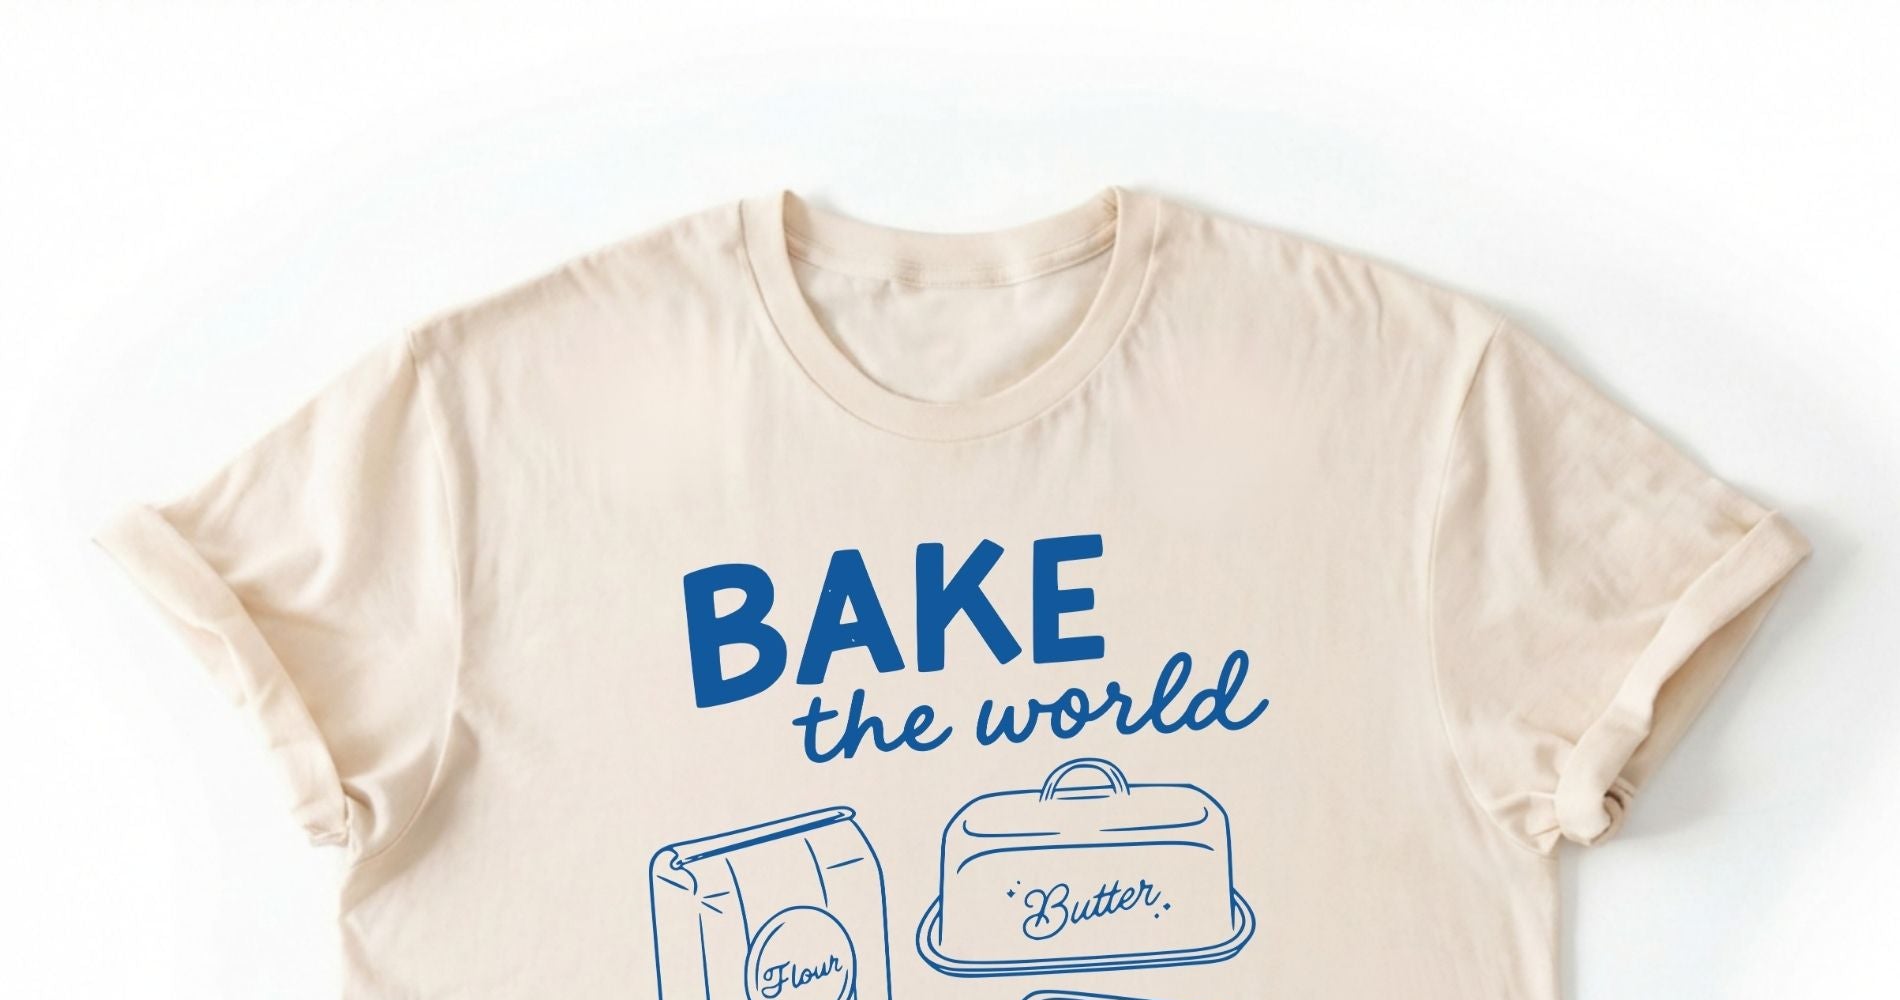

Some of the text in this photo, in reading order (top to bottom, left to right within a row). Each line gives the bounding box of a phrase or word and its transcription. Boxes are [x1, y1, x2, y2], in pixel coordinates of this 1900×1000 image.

[682, 533, 1105, 709] BAKE
[792, 649, 1270, 764] the world
[1022, 880, 1162, 942] Butter
[761, 955, 843, 1000] Flour
